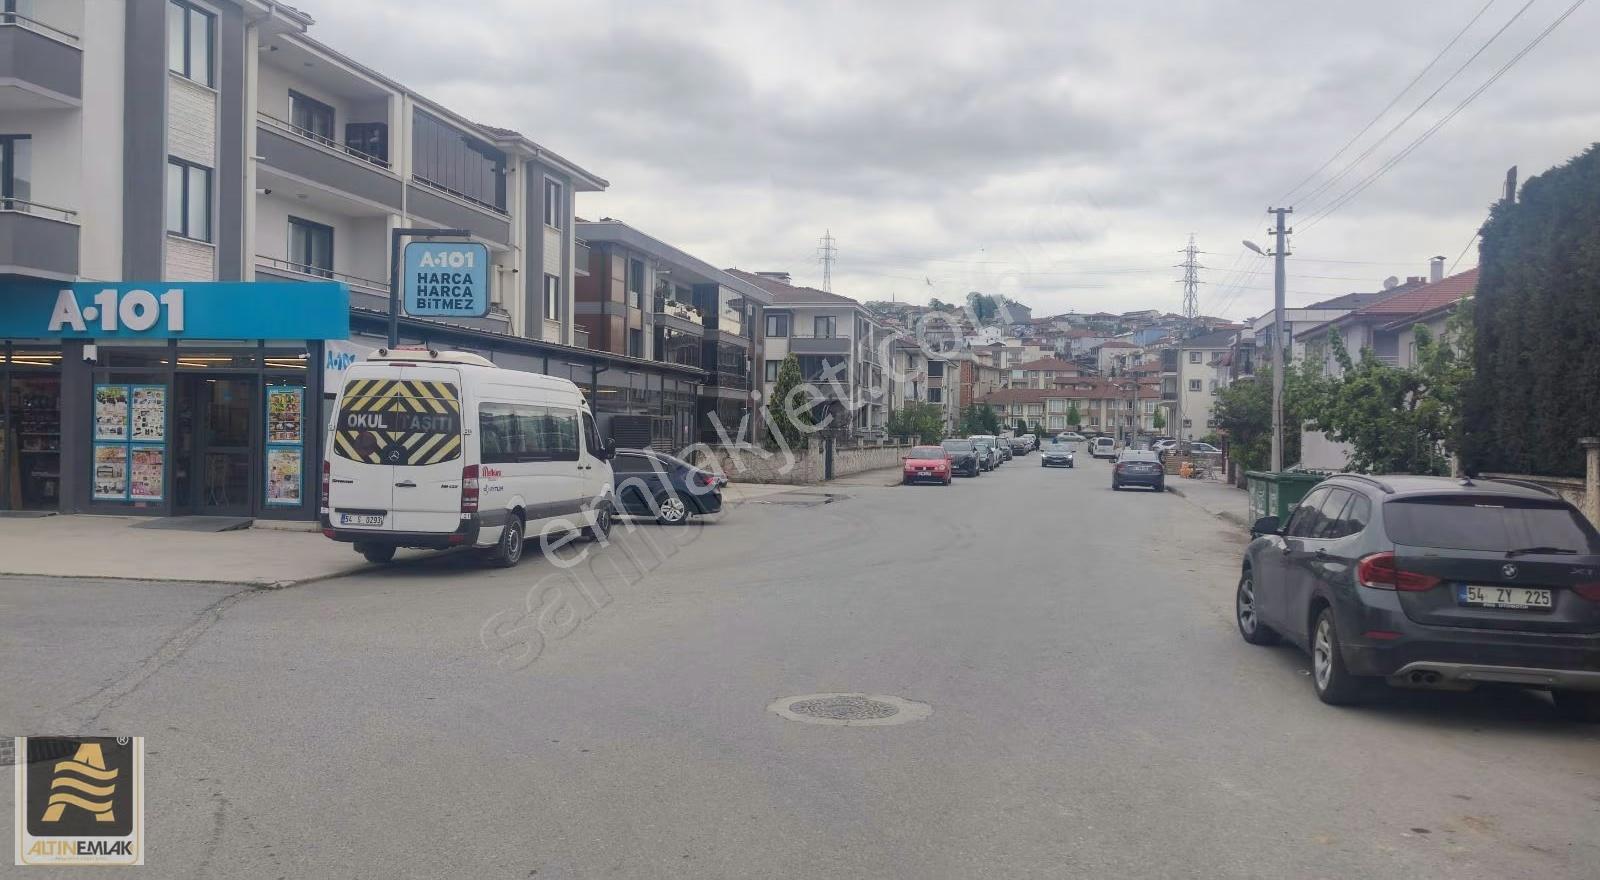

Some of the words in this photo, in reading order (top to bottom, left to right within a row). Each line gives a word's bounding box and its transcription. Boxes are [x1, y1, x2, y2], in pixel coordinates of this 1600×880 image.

[417, 272, 473, 285] HARCA
[417, 285, 473, 298] HARCA
[347, 413, 388, 429] OKUL
[1468, 587, 1484, 601] 54
[1497, 588, 1513, 603] ZY
[1525, 590, 1550, 605] 225
